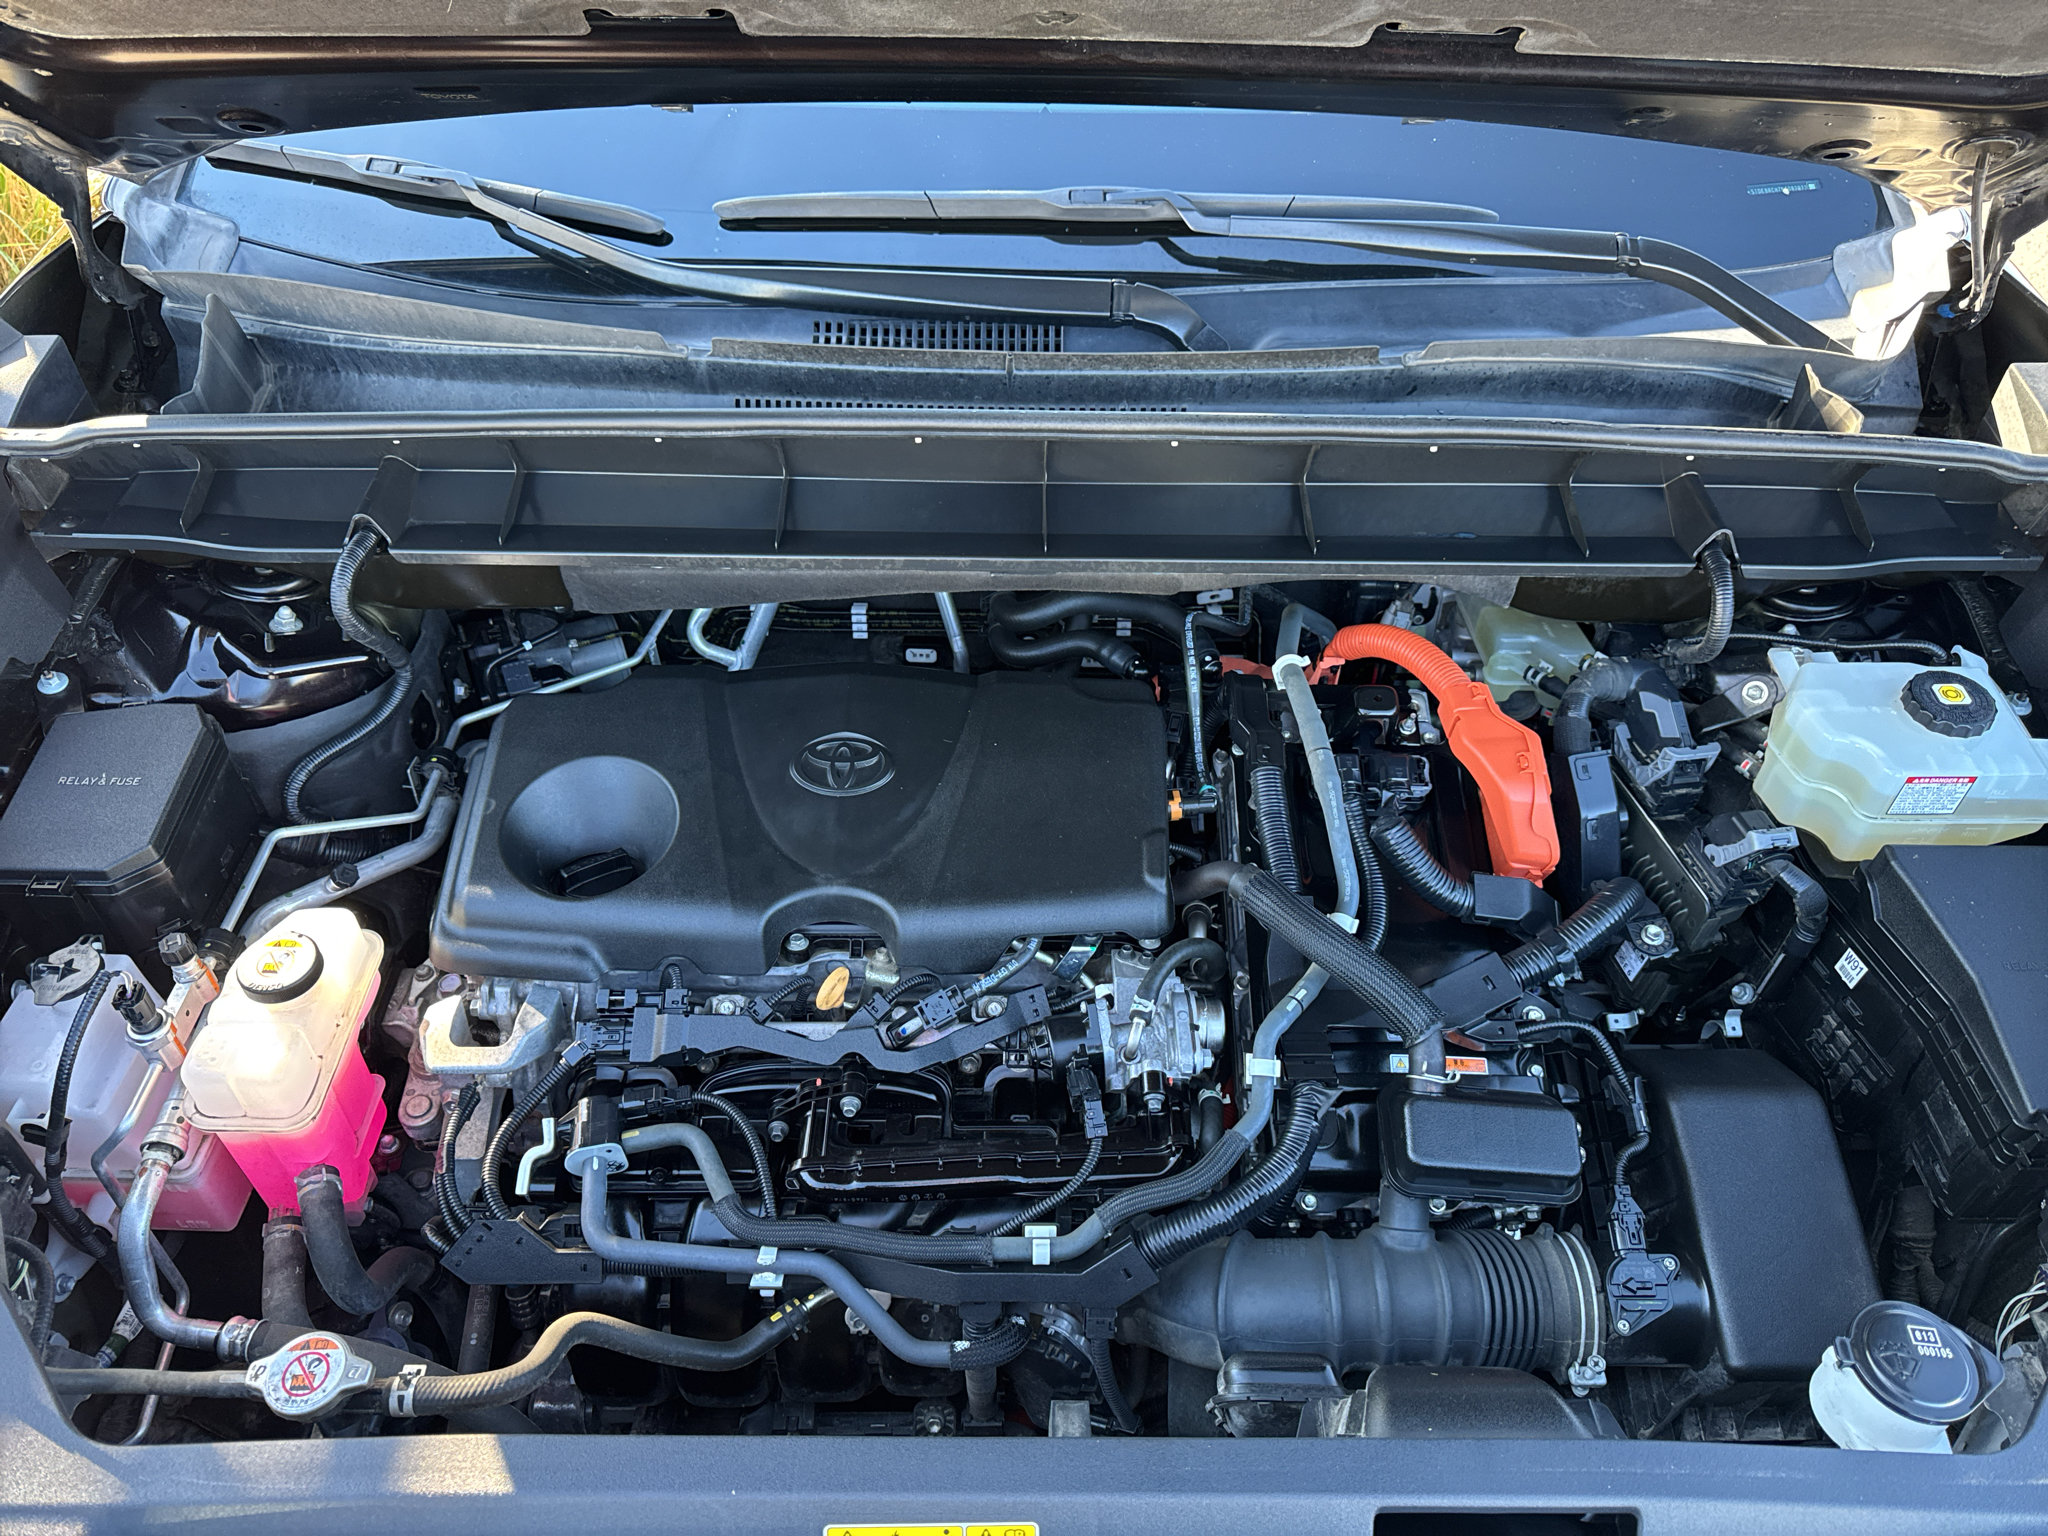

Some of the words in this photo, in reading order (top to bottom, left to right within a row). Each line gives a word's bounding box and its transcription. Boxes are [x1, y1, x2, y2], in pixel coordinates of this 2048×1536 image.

[57, 776, 98, 786] RELAY
[109, 777, 142, 786] FUSE
[1844, 951, 1864, 977] W91
[1918, 1345, 1954, 1359] 000105
